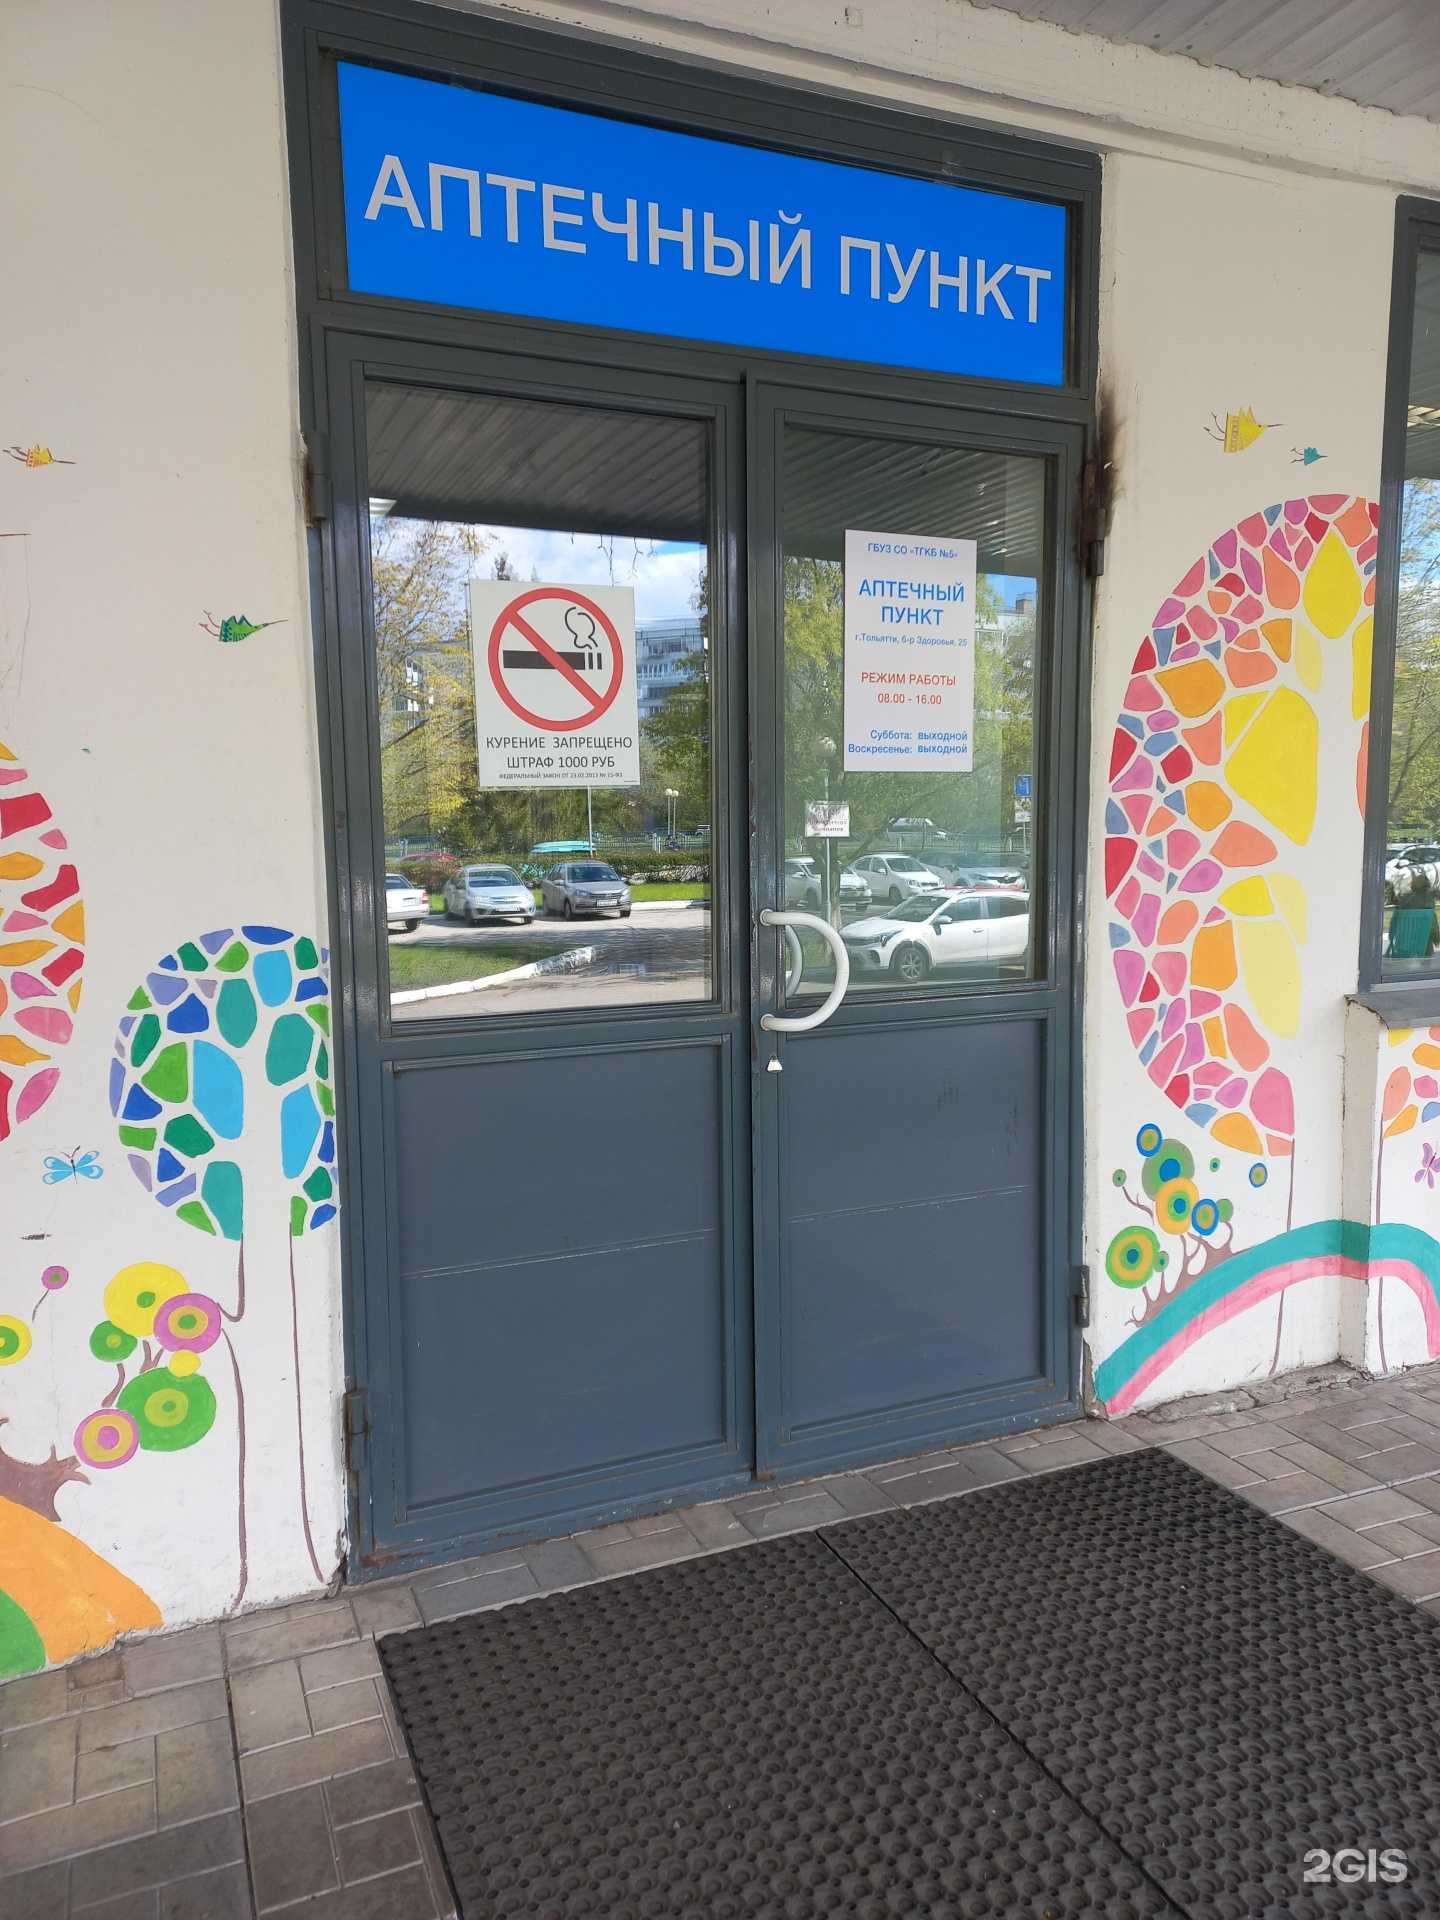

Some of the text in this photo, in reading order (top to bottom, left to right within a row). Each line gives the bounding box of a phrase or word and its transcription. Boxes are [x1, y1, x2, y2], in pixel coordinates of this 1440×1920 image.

[364, 154, 1052, 324] АПТЕЧНЫЙ ПУНКТ
[867, 542, 891, 554] ГБУЗ
[893, 544, 908, 555] СО
[859, 578, 965, 603] АПТЕЧНЫЙ
[881, 606, 944, 626] ПУНКТ
[901, 634, 915, 645] б-р
[958, 638, 968, 648] 25
[861, 671, 956, 686] РЕЖИМ РАБОТЫ
[877, 692, 905, 704] 08.00
[916, 694, 942, 705] 16.00
[486, 736, 632, 750] КУРЕНИЕ ЗАПРЕЩЕНО
[870, 729, 968, 743] Суббота: выходной
[848, 743, 968, 755] Воскресенье: выходной
[507, 756, 615, 769] ШТРАФ 1000 РУБ
